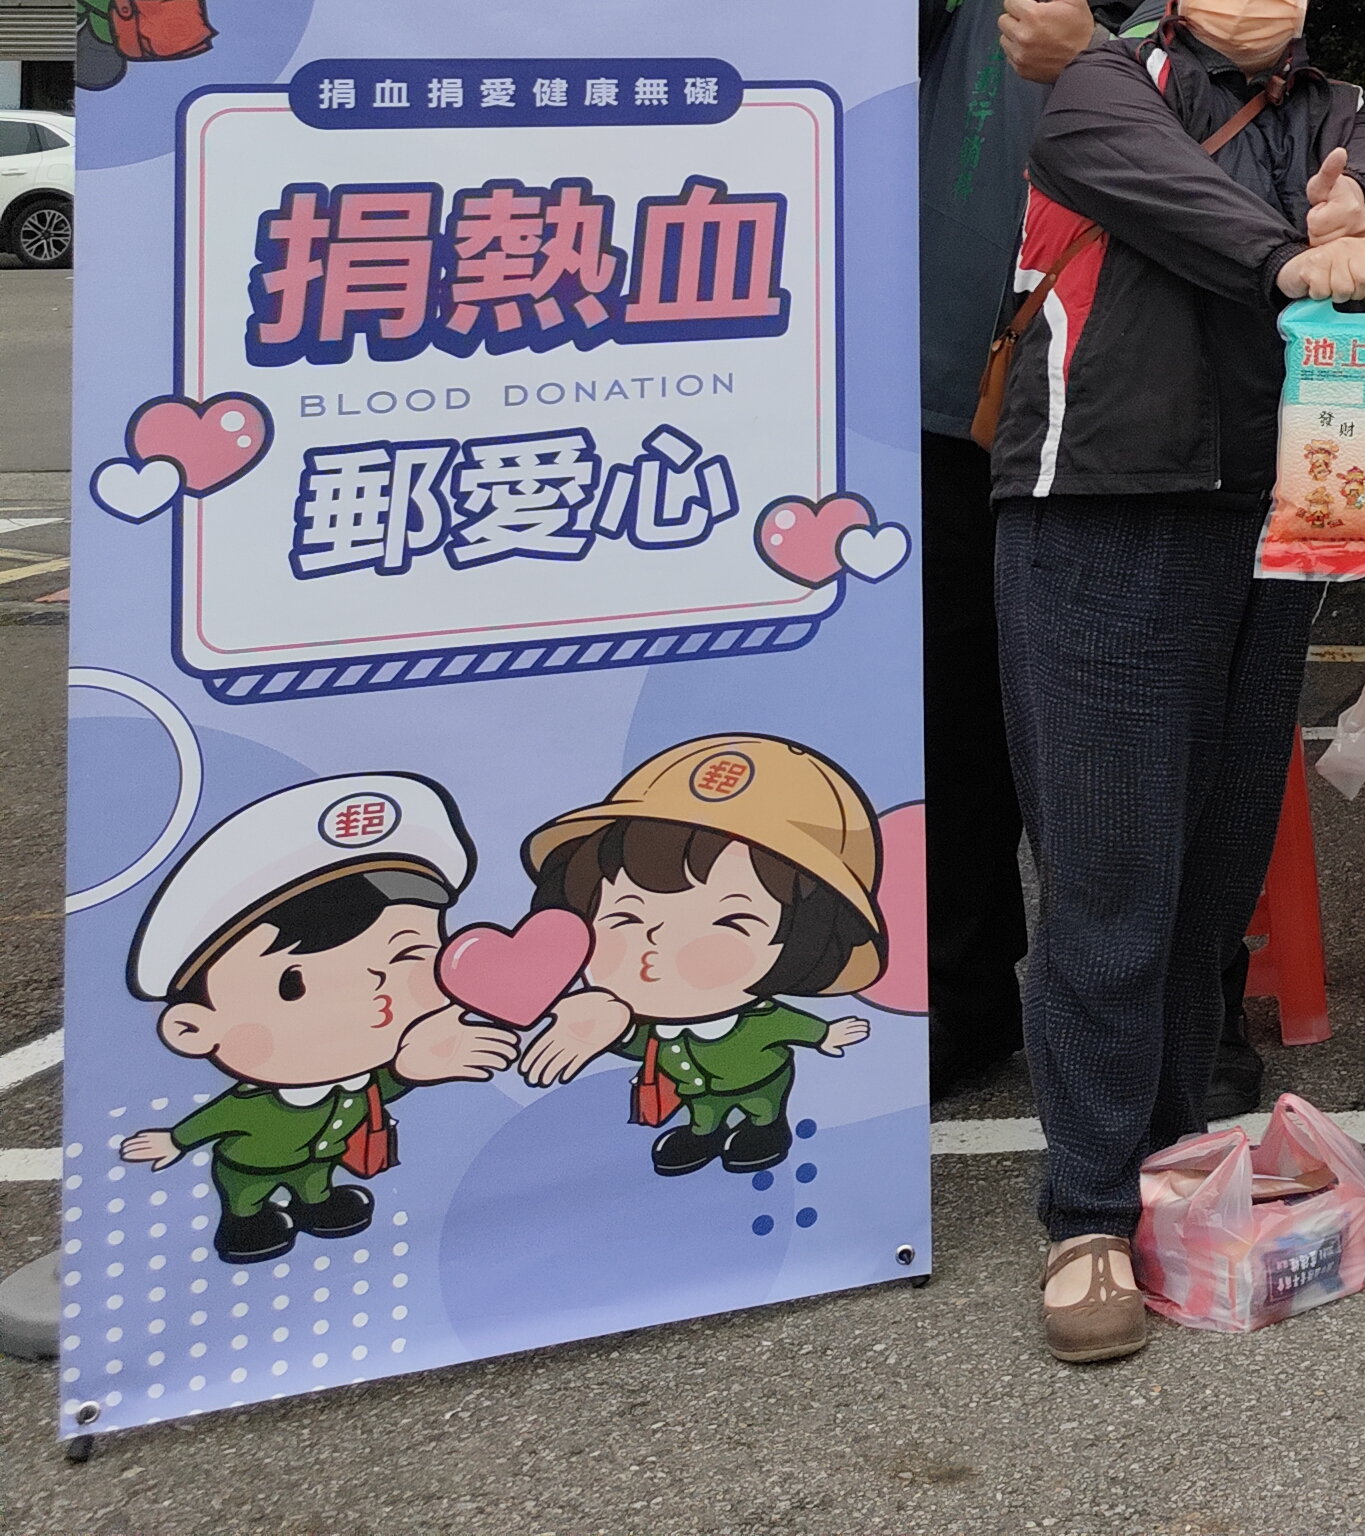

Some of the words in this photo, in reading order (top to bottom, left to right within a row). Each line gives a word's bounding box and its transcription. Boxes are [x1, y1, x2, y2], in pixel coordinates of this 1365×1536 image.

[319, 76, 720, 110] 捐血捐愛健康無礙
[248, 177, 790, 359] 捐熱血
[300, 383, 472, 418] BLOOD
[504, 373, 736, 408] DONATION
[1318, 411, 1355, 438] 發財
[292, 425, 738, 578] 郵愛心
